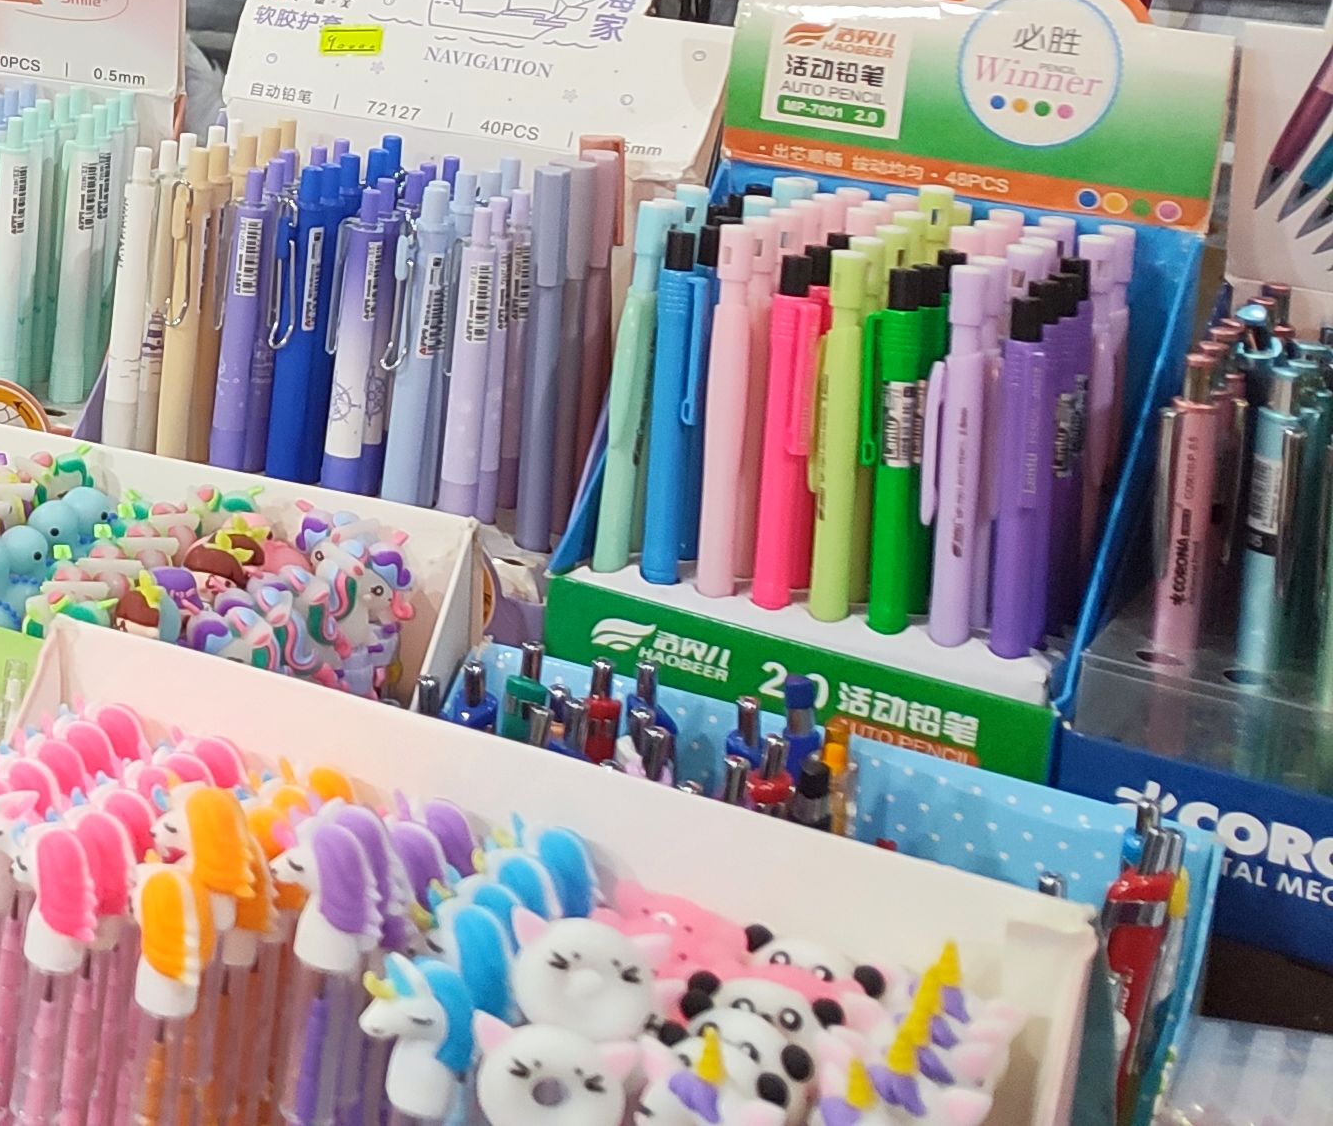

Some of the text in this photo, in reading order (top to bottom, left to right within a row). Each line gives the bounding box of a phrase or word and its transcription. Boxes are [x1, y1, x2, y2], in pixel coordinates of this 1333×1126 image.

[822, 40, 895, 59] HAOBEER
[1012, 23, 1083, 56] 必胜
[93, 66, 146, 86] 0.5mm
[423, 46, 554, 79] NAVIGATION
[785, 54, 885, 87] 活动铅笔
[975, 54, 1103, 97] Winner
[780, 80, 886, 105] AUTO PENCIL
[366, 100, 422, 121] 72127
[853, 109, 879, 124] 2.0
[480, 120, 541, 142] 40PCS
[944, 170, 1010, 194] 48PCS
[1173, 537, 1191, 594] CORONA
[637, 646, 730, 683] HAOBEER
[837, 681, 980, 749] 活动铅笔
